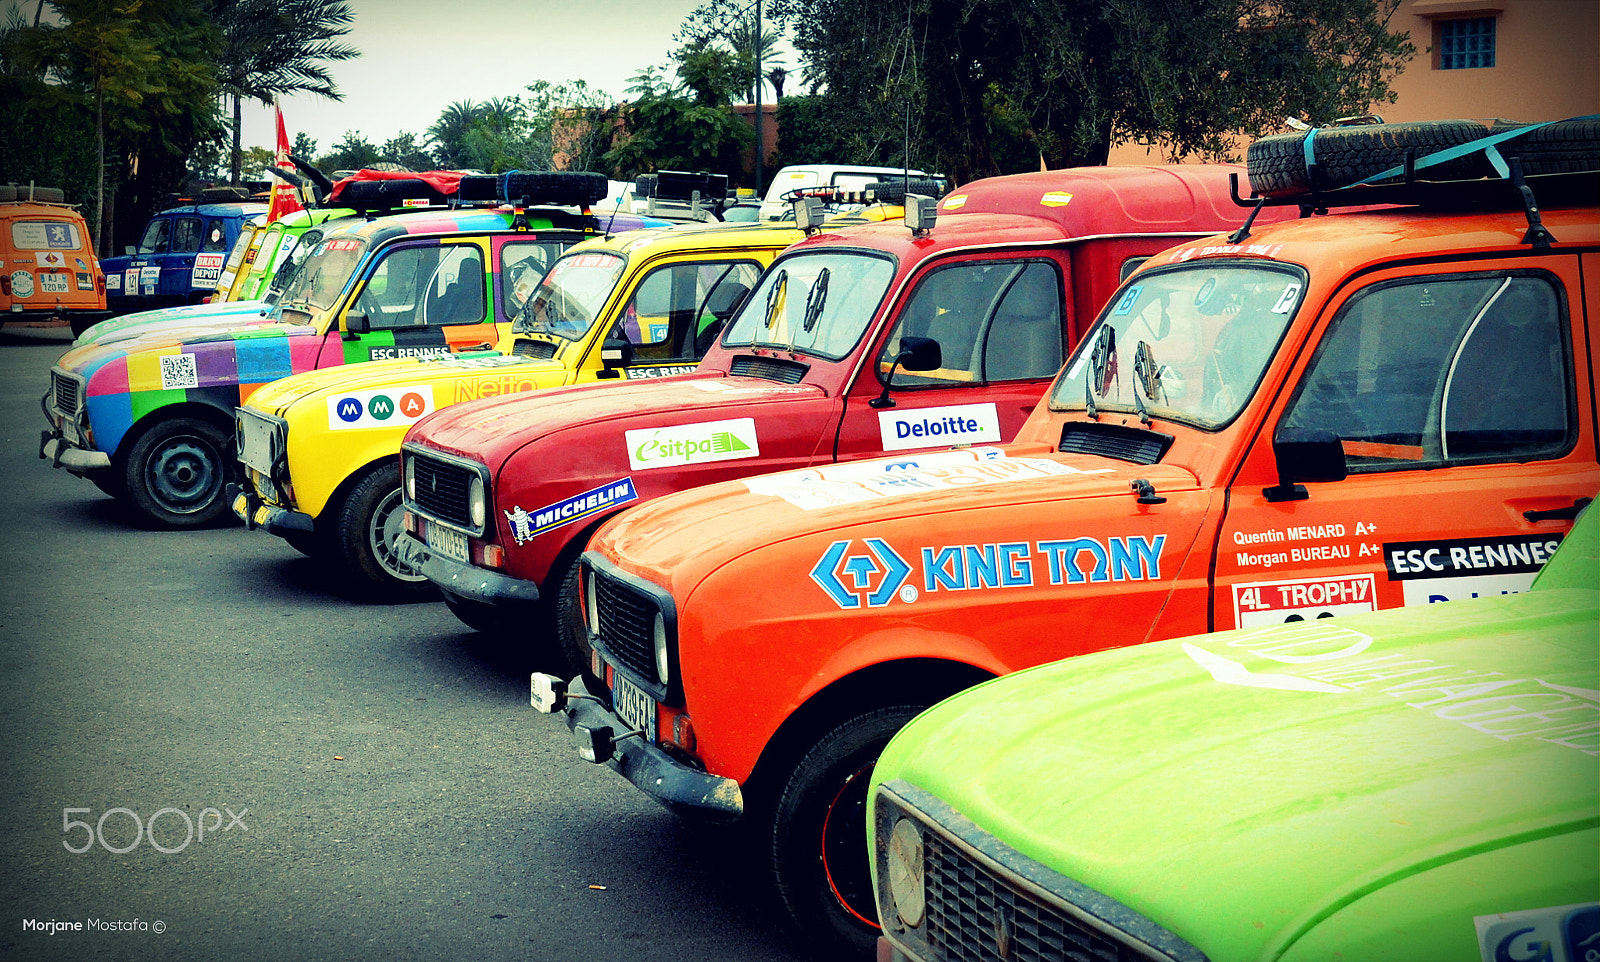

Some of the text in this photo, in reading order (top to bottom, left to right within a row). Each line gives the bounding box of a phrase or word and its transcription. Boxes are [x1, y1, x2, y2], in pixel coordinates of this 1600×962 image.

[197, 256, 221, 267] BRICO
[42, 283, 57, 292] 720
[48, 274, 58, 282] AJ
[1119, 288, 1139, 311] B
[1276, 287, 1298, 309] P
[371, 347, 449, 361] ESC RENNES
[628, 368, 657, 379] ESC
[454, 376, 538, 404] Netto
[895, 415, 984, 439] Deloitte.
[536, 483, 630, 529] MICHELIN
[1233, 521, 1377, 546] Quentin MENARD A+
[920, 533, 1168, 592] KING TONY
[1237, 542, 1380, 568] Morgan BUREAU A+
[1391, 540, 1560, 574] ESC RENNES
[1239, 579, 1370, 610] 4L TROPHY
